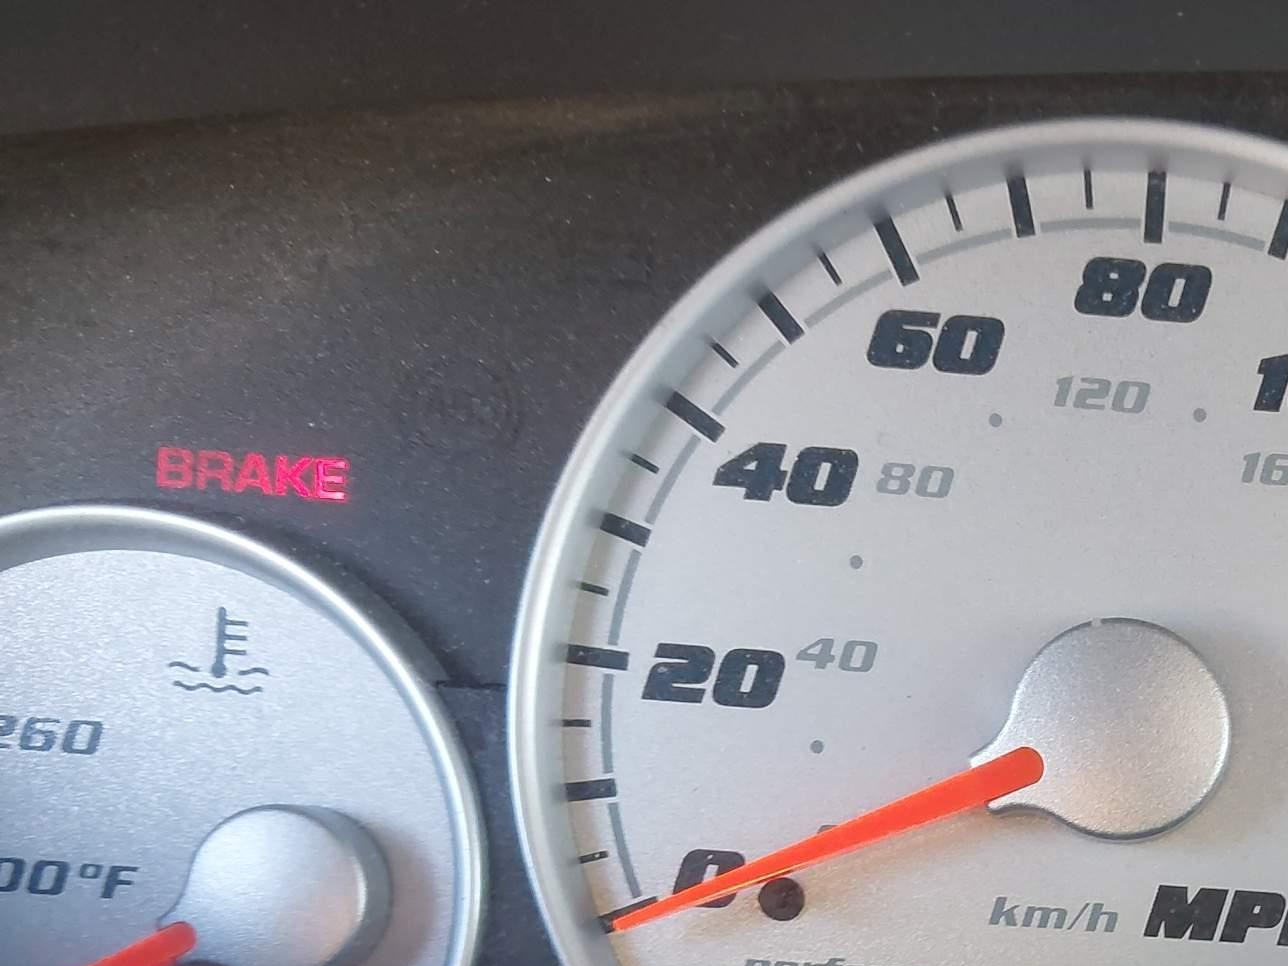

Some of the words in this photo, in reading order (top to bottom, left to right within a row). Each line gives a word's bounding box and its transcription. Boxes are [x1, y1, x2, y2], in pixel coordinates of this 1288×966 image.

[1074, 257, 1212, 323] 80
[866, 309, 1005, 375] 60
[1053, 376, 1151, 413] 120
[155, 447, 350, 503] BRAKE
[712, 442, 859, 507] 40
[876, 462, 955, 498] 80
[641, 642, 786, 710] 20
[795, 637, 878, 673] 40
[988, 897, 1119, 933] km/h
